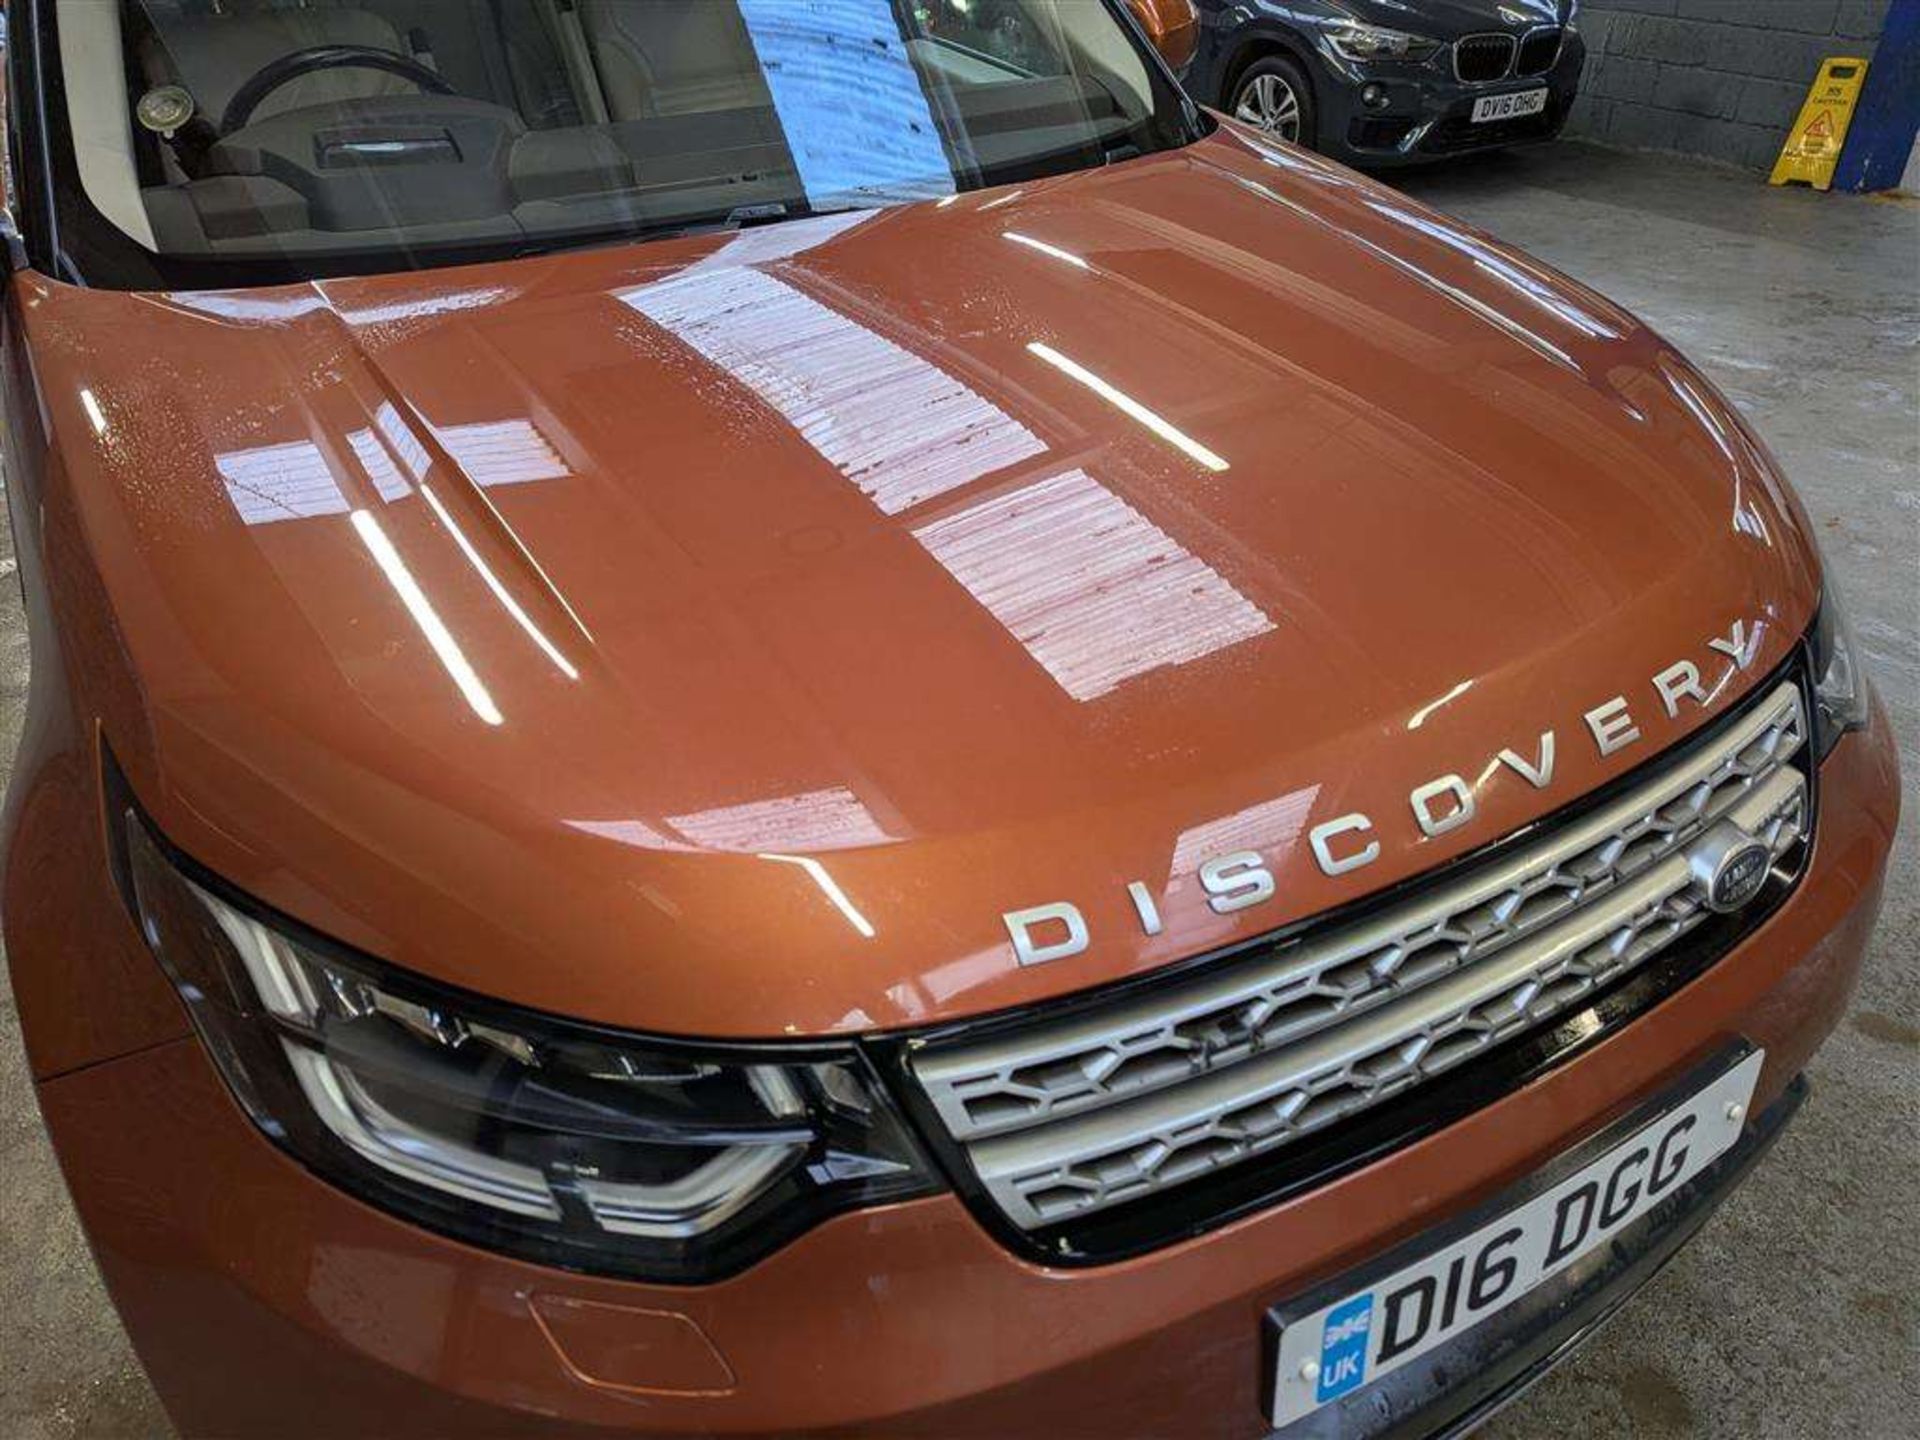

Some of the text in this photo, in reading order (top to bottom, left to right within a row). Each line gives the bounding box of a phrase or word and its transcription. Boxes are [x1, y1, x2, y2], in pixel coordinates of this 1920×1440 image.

[1481, 97, 1512, 118] DV16
[1003, 618, 1745, 966] DISCOVERY
[1375, 1114, 1697, 1365] D16 DGG
[1323, 1351, 1359, 1388] UK
